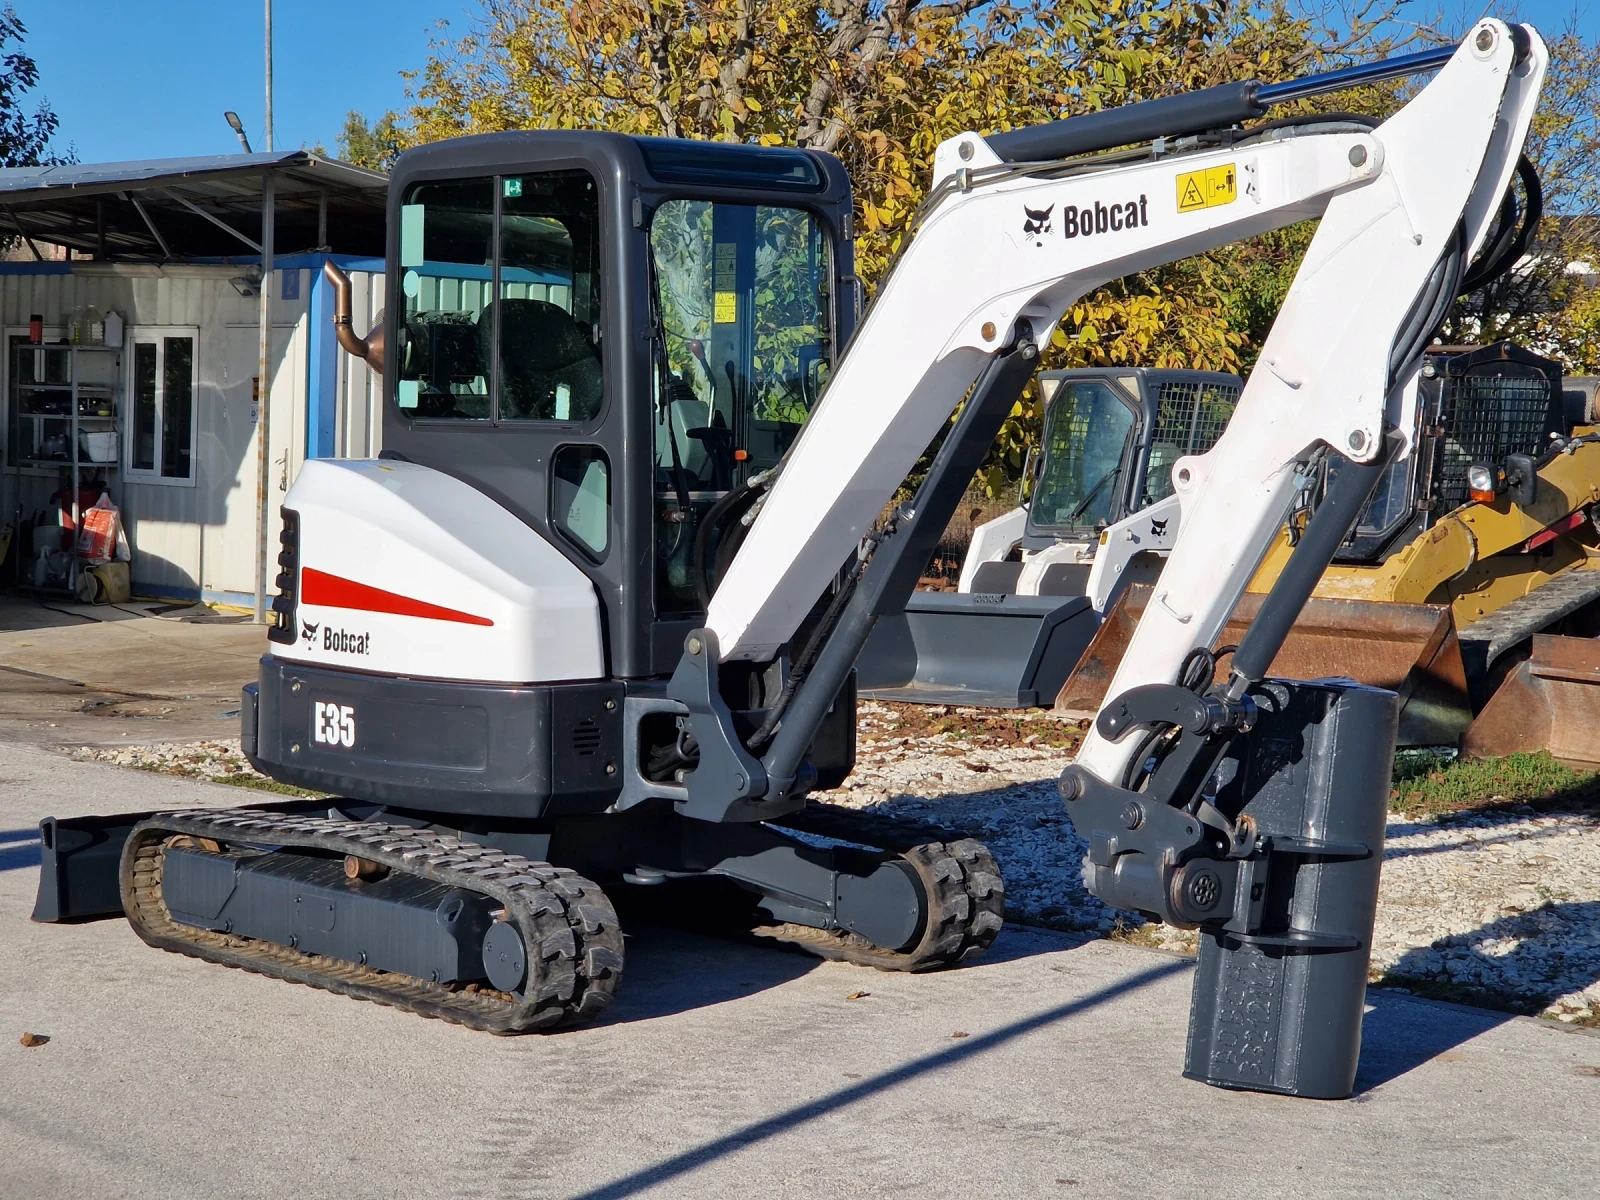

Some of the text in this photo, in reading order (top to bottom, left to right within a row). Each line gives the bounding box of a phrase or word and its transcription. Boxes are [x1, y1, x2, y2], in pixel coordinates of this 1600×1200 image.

[1063, 193, 1149, 240] Bobcat
[323, 626, 370, 656] Bobcat
[315, 701, 355, 747] E35
